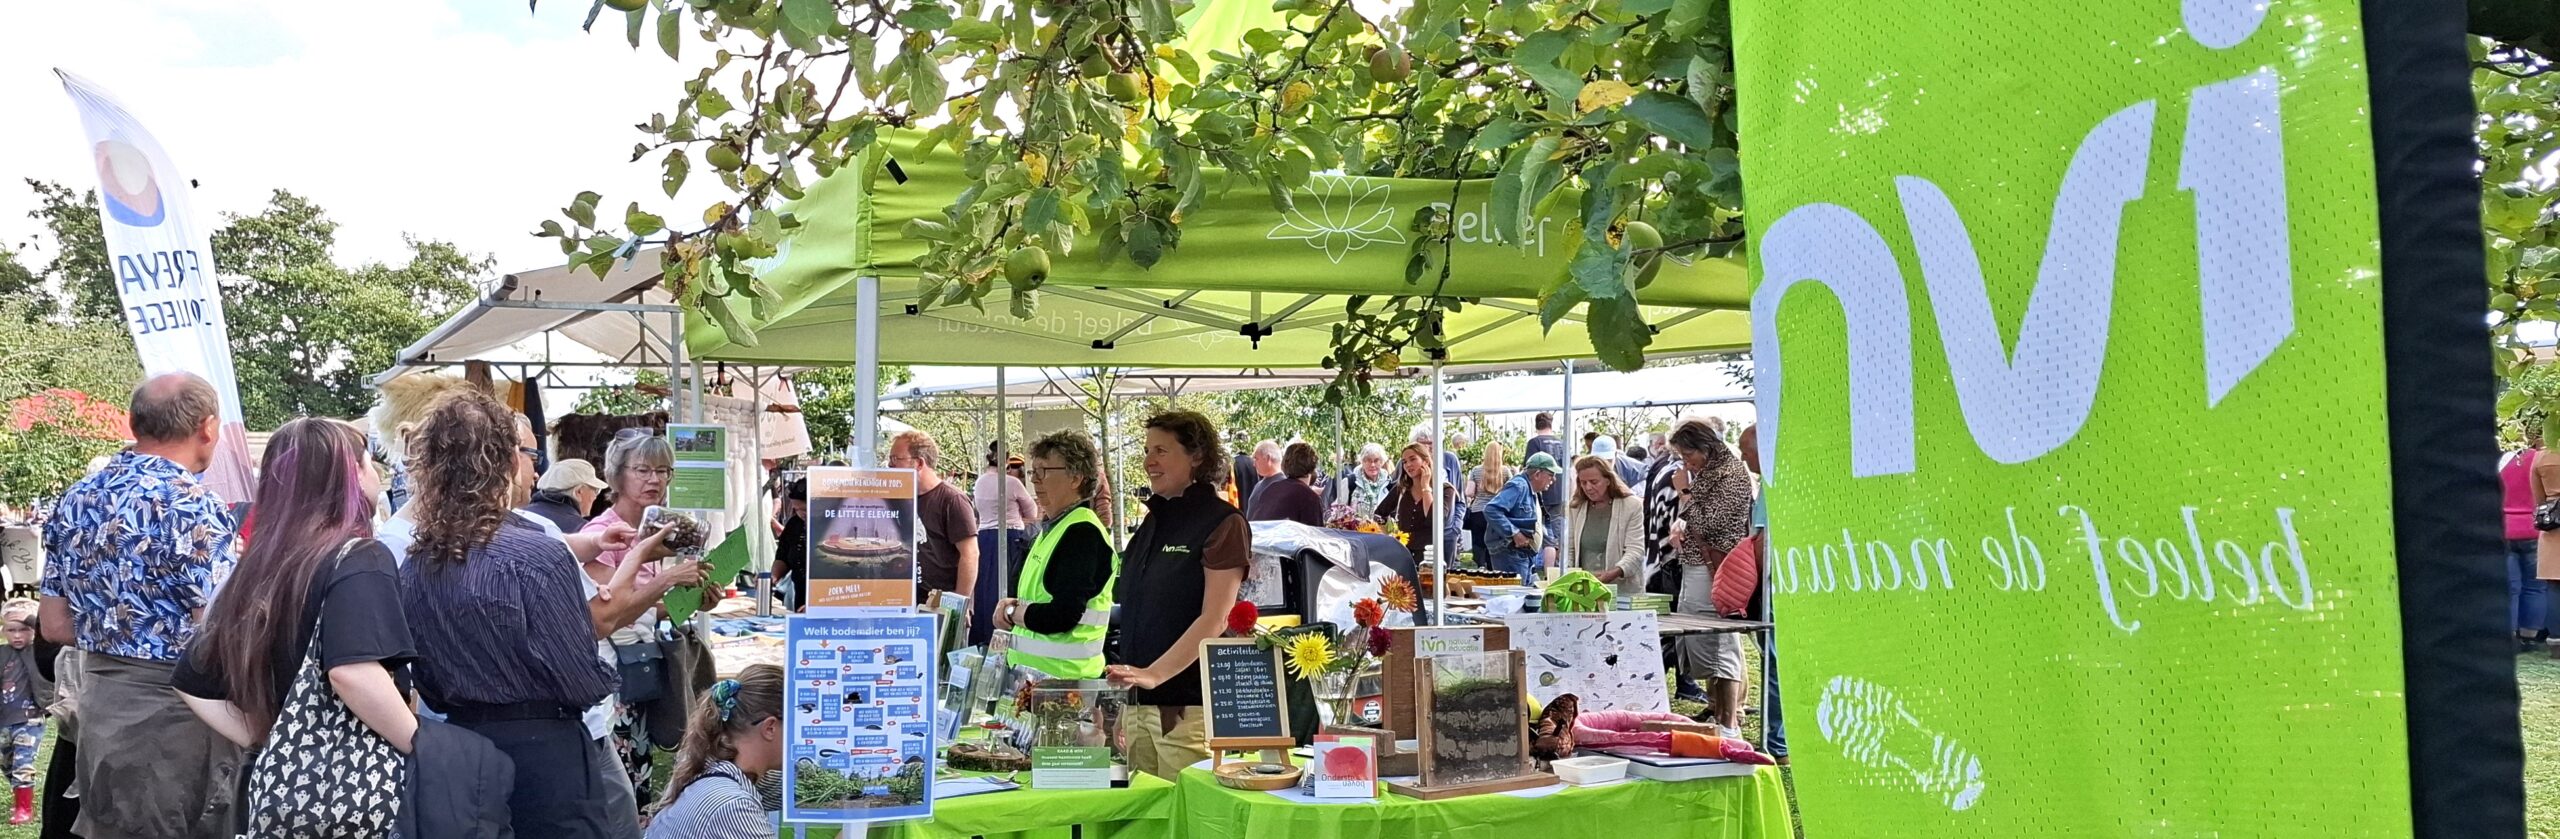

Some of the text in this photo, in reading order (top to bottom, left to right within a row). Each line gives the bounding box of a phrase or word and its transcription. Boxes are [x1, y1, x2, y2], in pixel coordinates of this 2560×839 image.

[888, 480, 902, 488] 2025
[825, 510, 899, 519] DE LITTLE ELEVEN!
[828, 586, 845, 596] ZOEK
[804, 626, 920, 637] Welk bodemdier ben jij?
[1421, 636, 1446, 652] ivn
[1321, 773, 1355, 781] Onderste
[1342, 781, 1365, 789] boven
